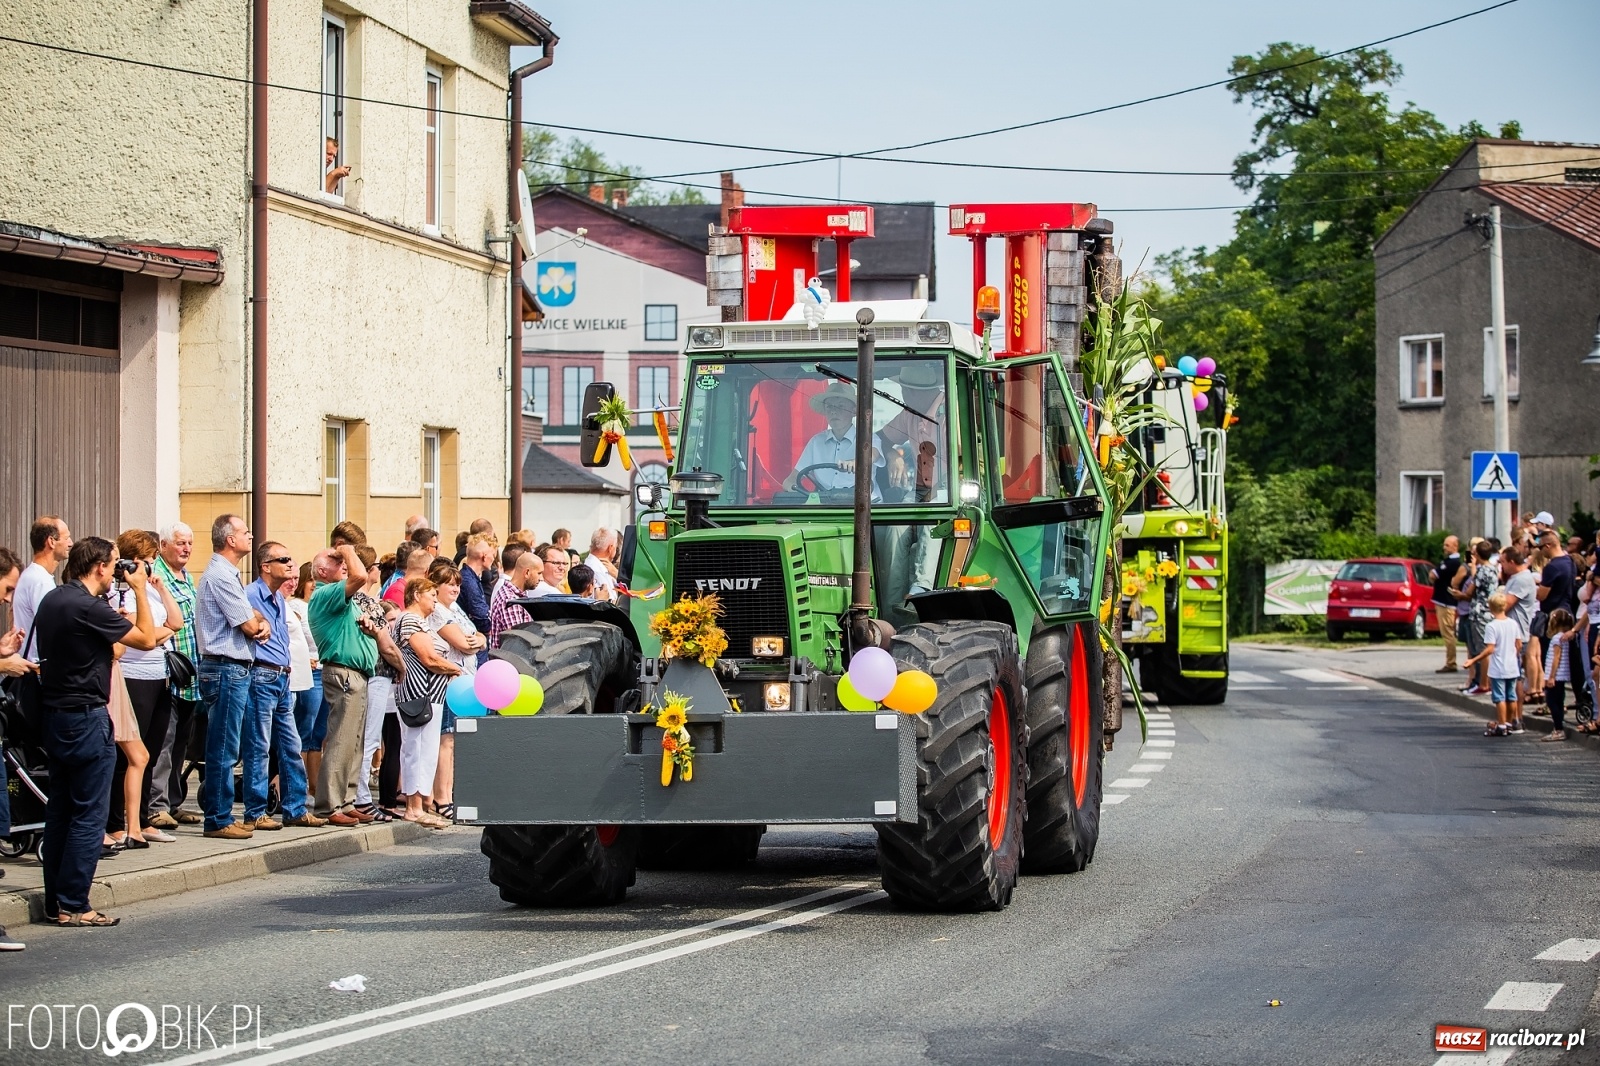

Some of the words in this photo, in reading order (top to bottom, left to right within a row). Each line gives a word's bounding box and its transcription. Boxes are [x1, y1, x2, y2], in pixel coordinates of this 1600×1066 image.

[1014, 256, 1021, 270] P
[1021, 278, 1029, 319] 600
[573, 318, 628, 330] WIELKIE
[694, 577, 762, 591] FENDT
